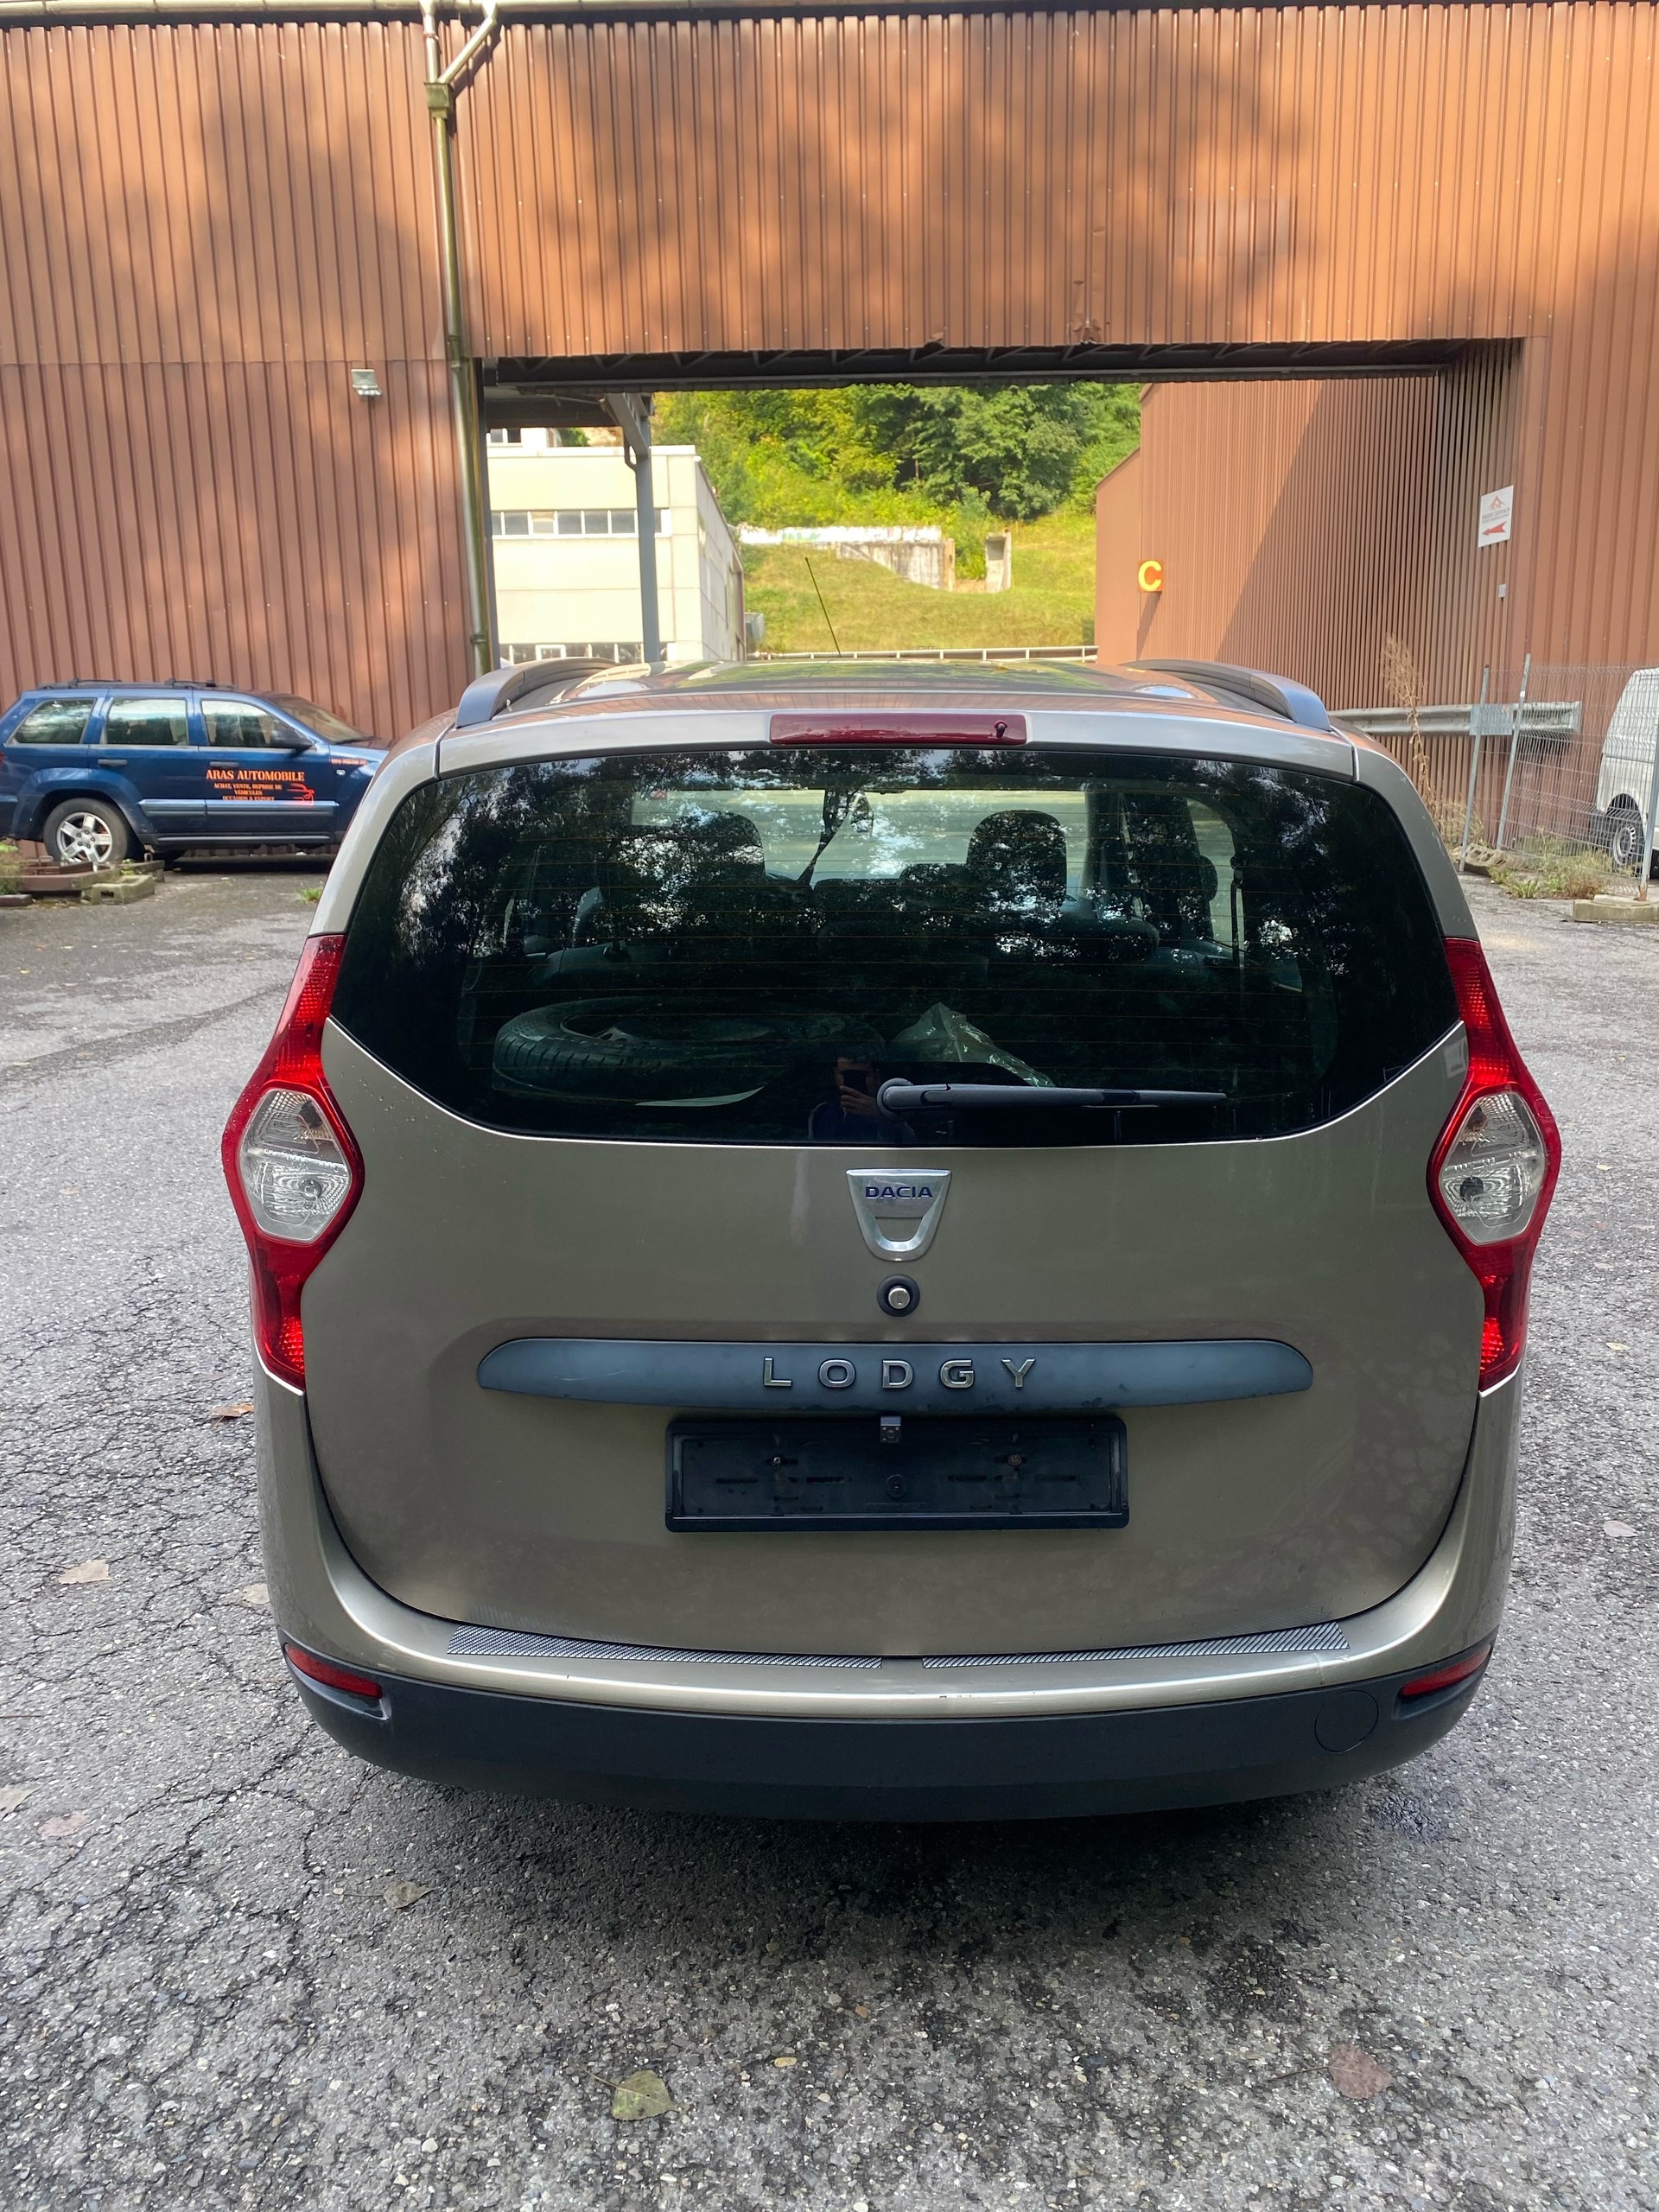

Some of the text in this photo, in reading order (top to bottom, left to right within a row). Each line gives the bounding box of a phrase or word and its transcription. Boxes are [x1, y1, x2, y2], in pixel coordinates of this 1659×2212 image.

[1138, 560, 1162, 592] C
[207, 770, 305, 781] ARAS AUTOMOBILE
[865, 1186, 933, 1198] DACIA
[763, 1357, 1036, 1389] LODGY
